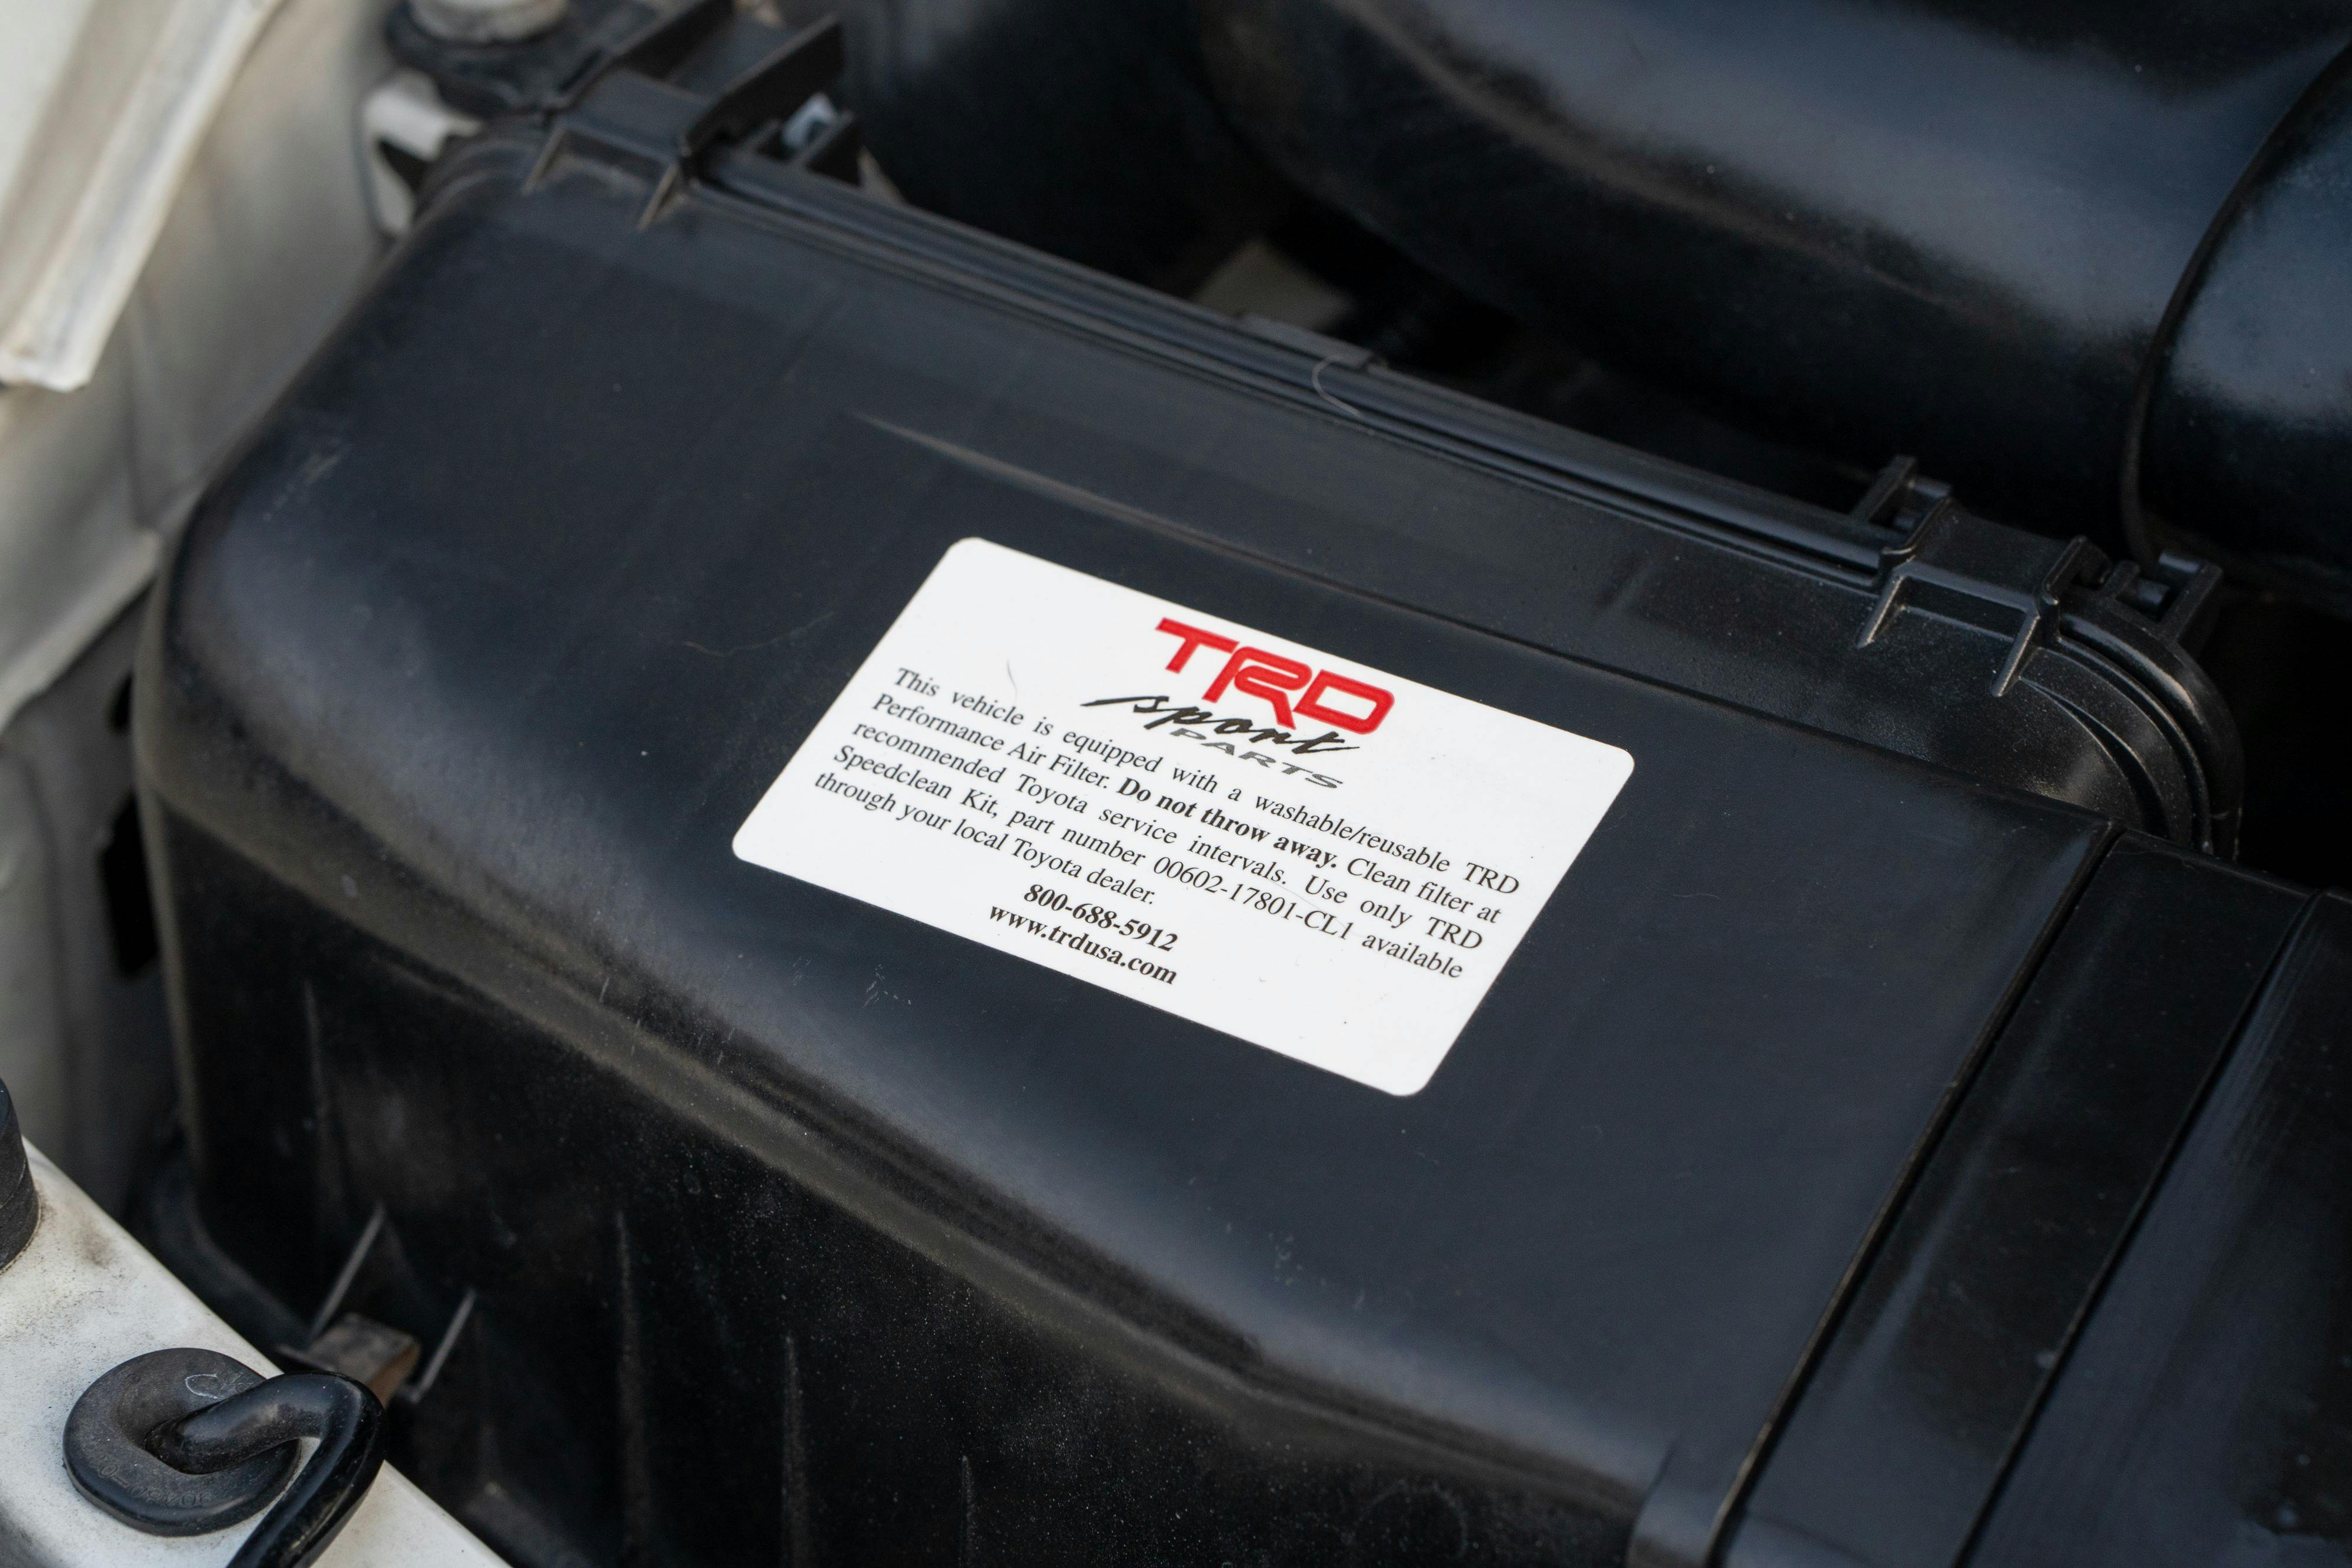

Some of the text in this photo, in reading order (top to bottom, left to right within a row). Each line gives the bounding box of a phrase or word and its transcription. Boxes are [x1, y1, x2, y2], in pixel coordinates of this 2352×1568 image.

[1080, 695, 1360, 755] sport
[1156, 617, 1395, 735] TRD
[873, 694, 1502, 924] Performance Air Filter. Do not throw away. Clean filter at
[896, 668, 1520, 894] This vehicle is equipped with a washable/reusable TRD
[1169, 728, 1345, 790] PARTS
[815, 773, 1155, 905] through your local Toyota dealer.
[834, 745, 1463, 978] Speedclean Kit, part number 00602-17801-CL1 available
[853, 724, 1483, 949] recommended Toyota service intervals. Use only TRD
[990, 906, 1177, 985] www.trdusa.com
[1024, 884, 1178, 952] 800-688-5912
